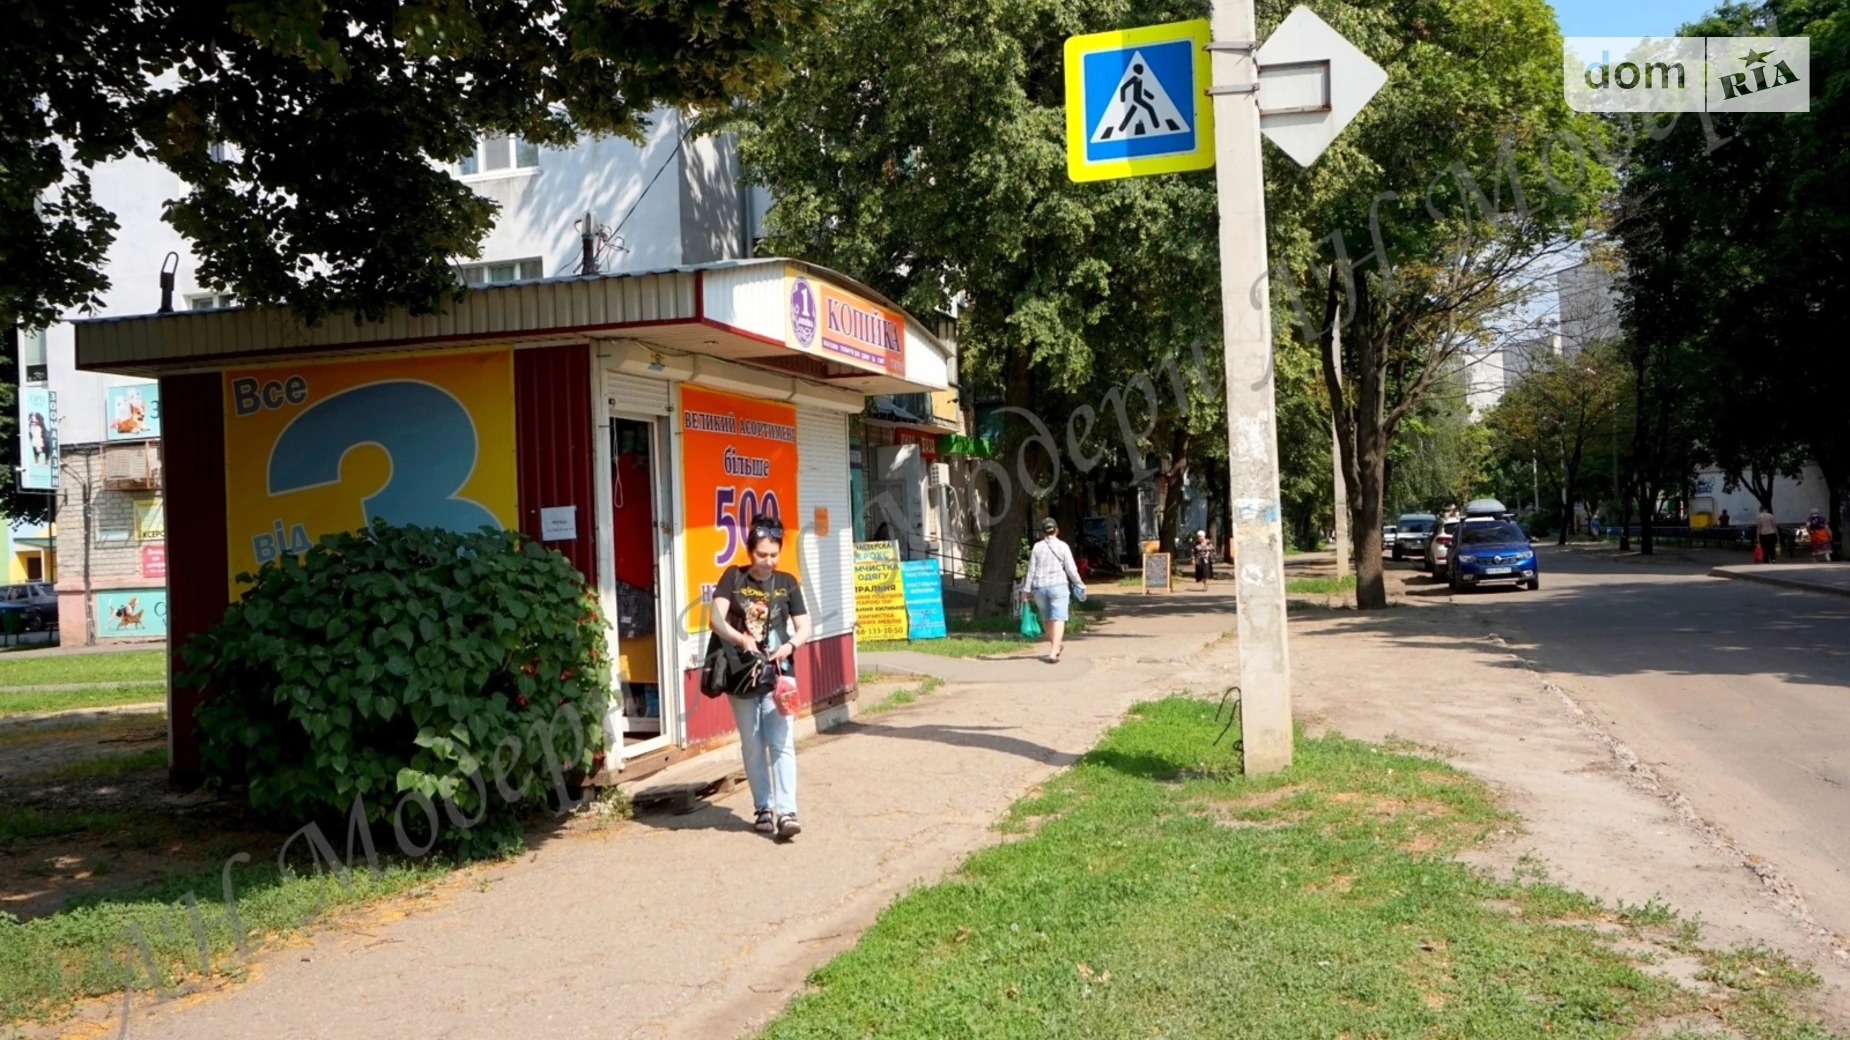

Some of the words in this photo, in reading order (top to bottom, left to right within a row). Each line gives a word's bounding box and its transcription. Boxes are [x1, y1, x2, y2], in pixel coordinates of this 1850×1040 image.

[827, 297, 901, 352] КОПІЙКА
[231, 374, 308, 417] Все
[48, 391, 59, 488] ЗООМАГАЗИН
[684, 411, 737, 434] ВЕЛИКИЙ
[723, 446, 769, 477] більше
[252, 519, 313, 564] від
[857, 572, 889, 582] ОДЯГУ
